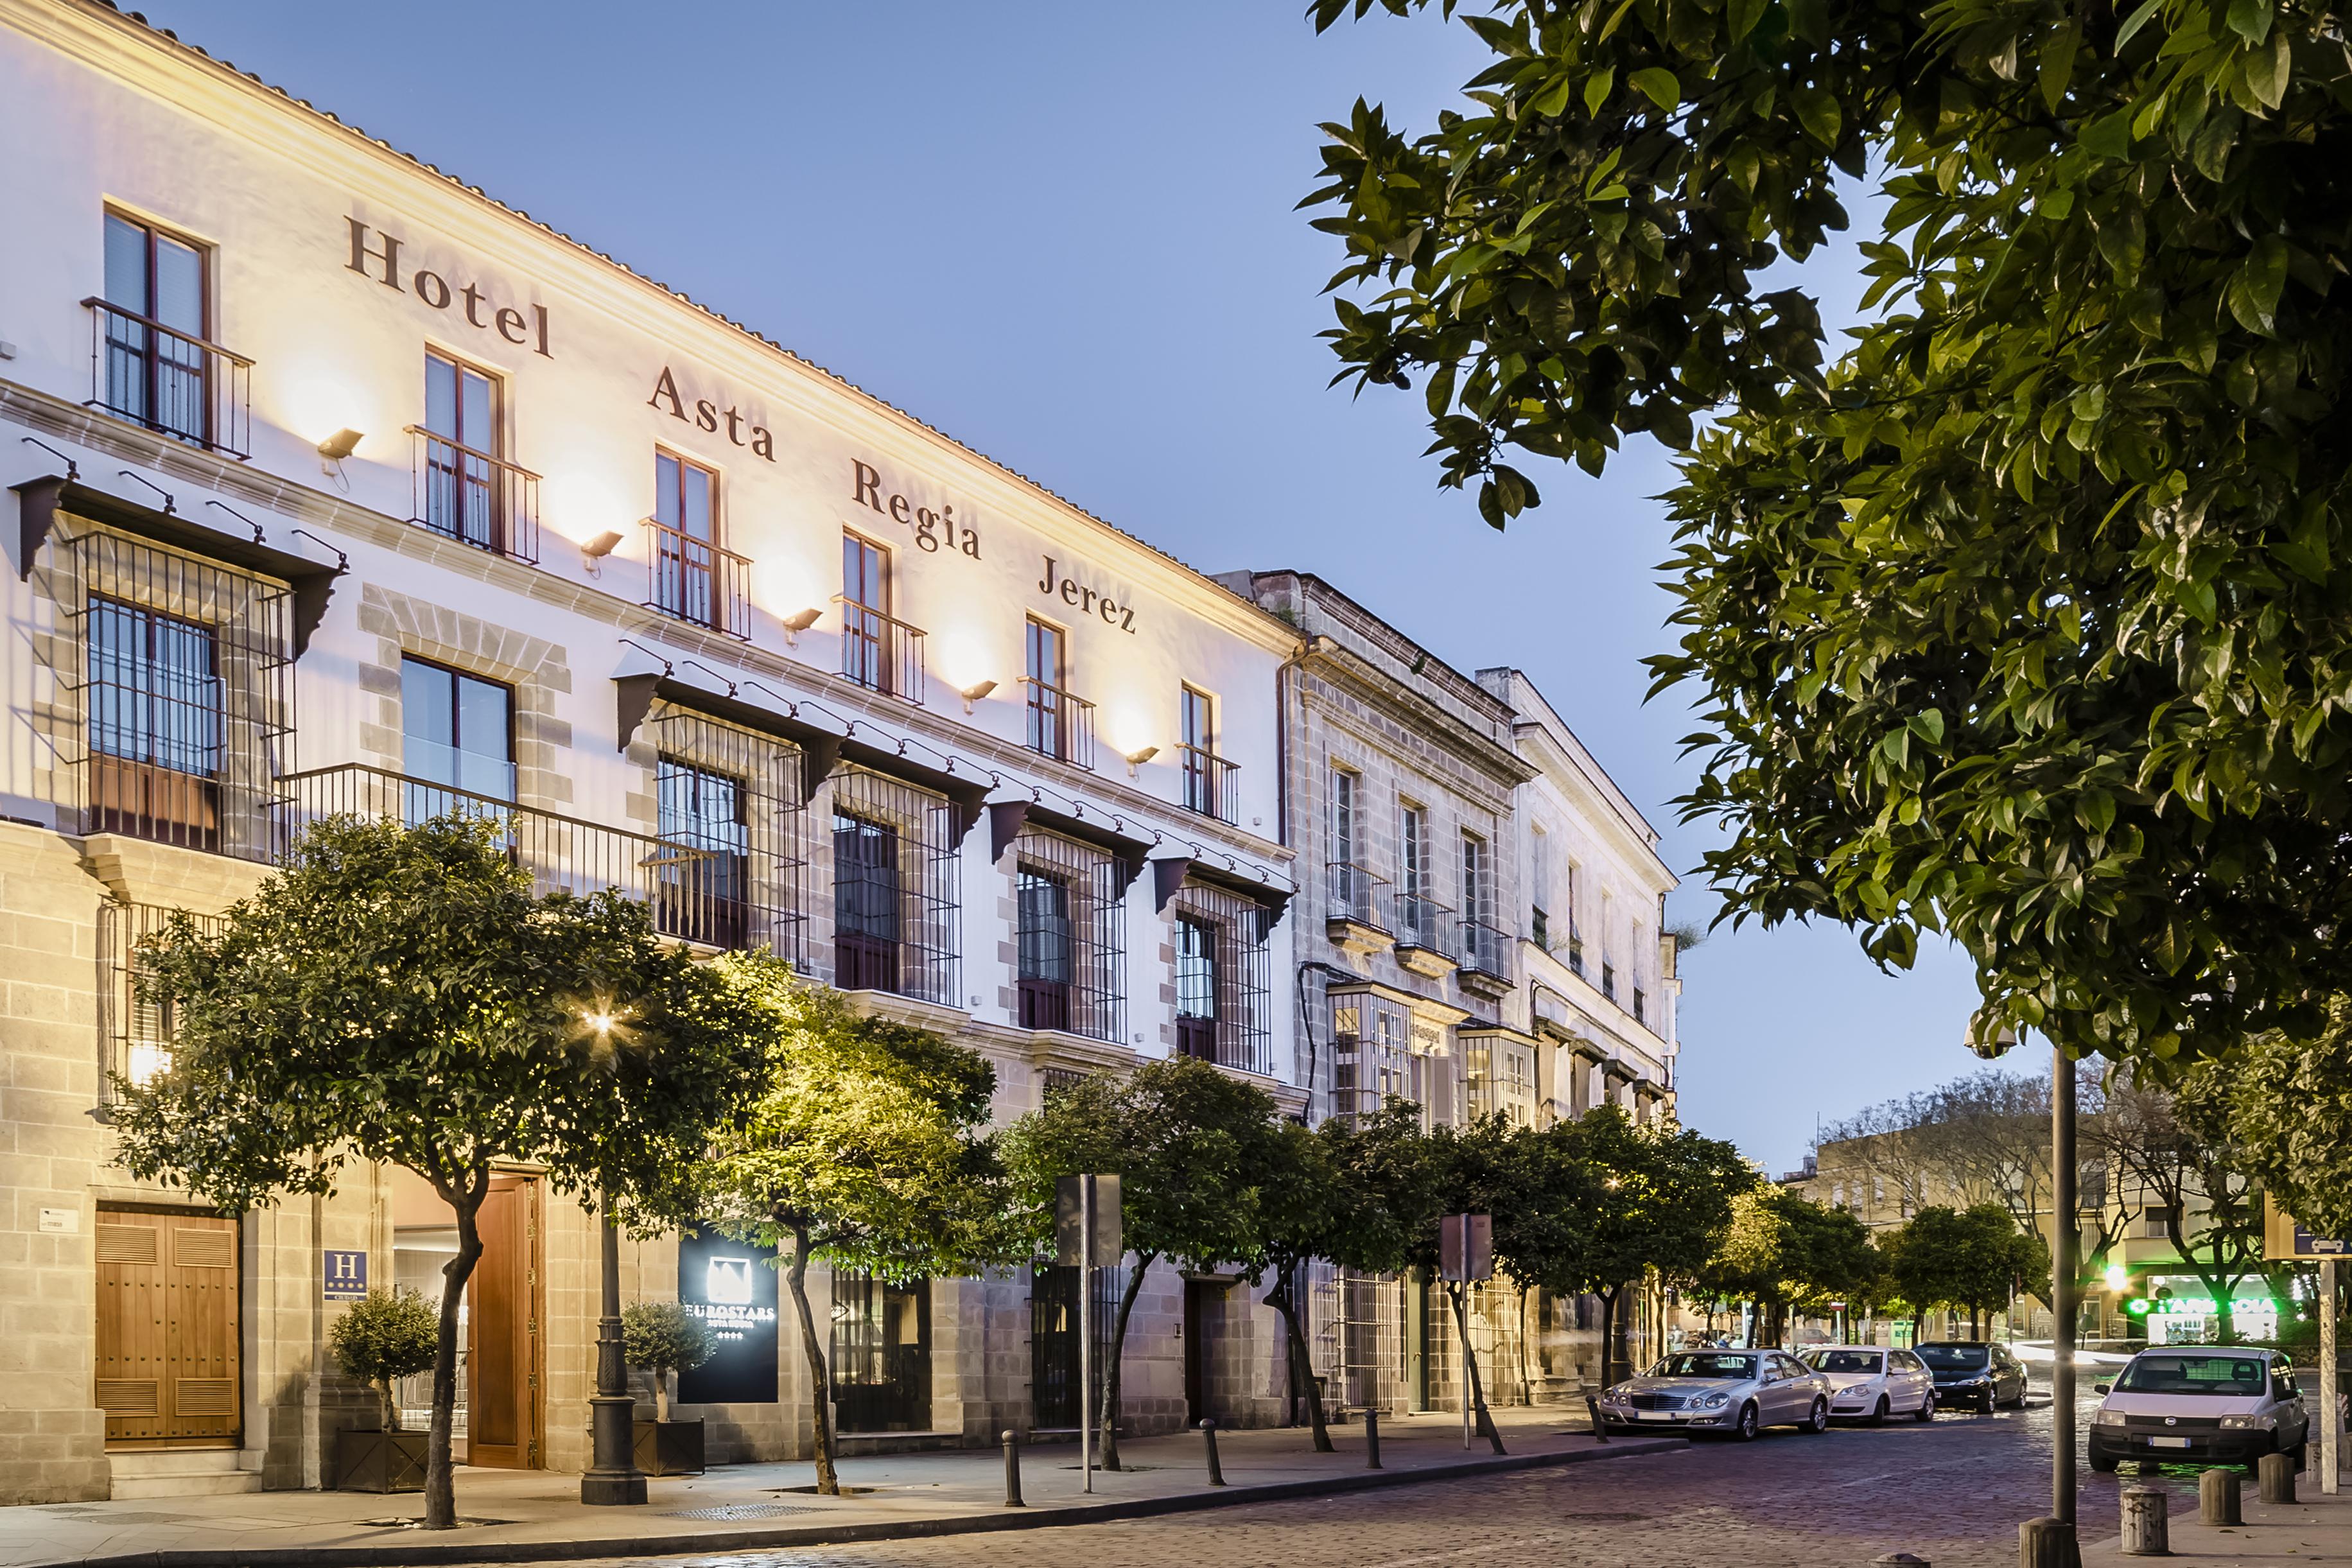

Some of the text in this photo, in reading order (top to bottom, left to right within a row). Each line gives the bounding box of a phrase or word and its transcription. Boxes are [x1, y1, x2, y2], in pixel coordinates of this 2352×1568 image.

[343, 214, 1137, 634] Hotel Asta Regia Jerez
[334, 1254, 358, 1278] H
[684, 1304, 775, 1320] EUROSTARS
[2157, 1298, 2278, 1314] FARMCIA
